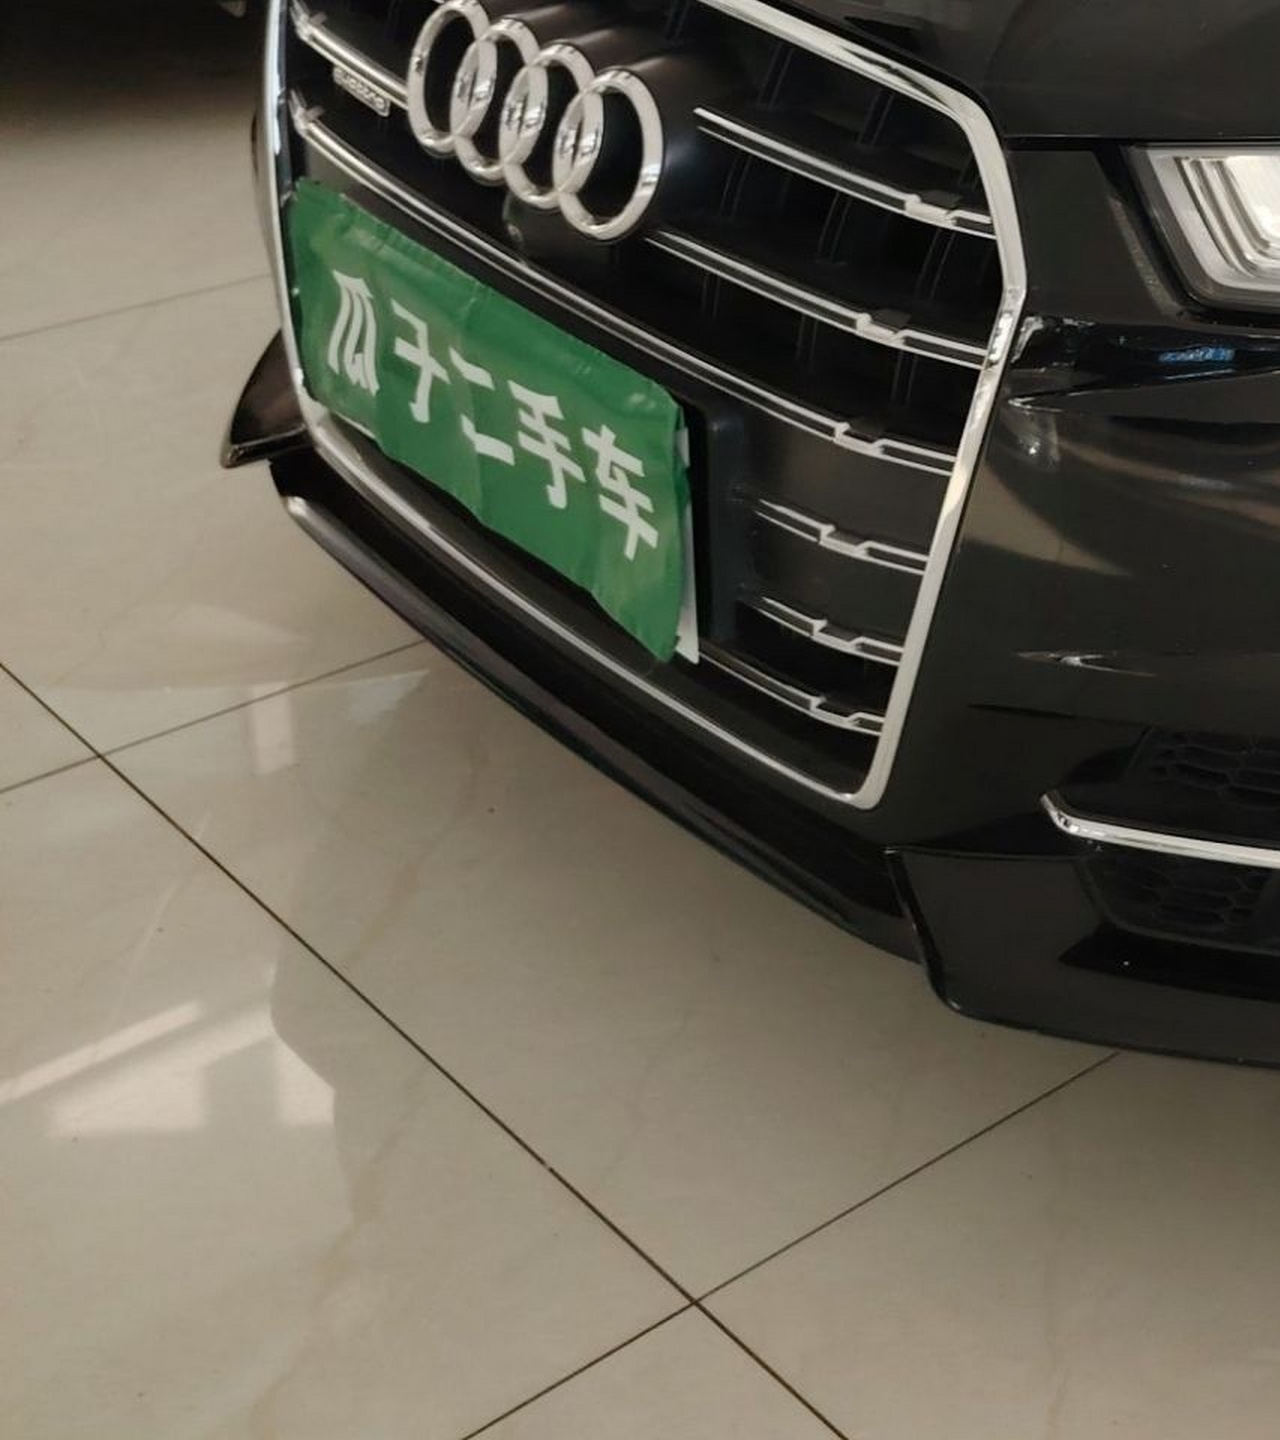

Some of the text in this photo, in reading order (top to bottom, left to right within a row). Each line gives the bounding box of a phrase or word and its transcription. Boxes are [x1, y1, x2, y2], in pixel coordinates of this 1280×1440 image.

[327, 269, 658, 560] 瓜子二手车
